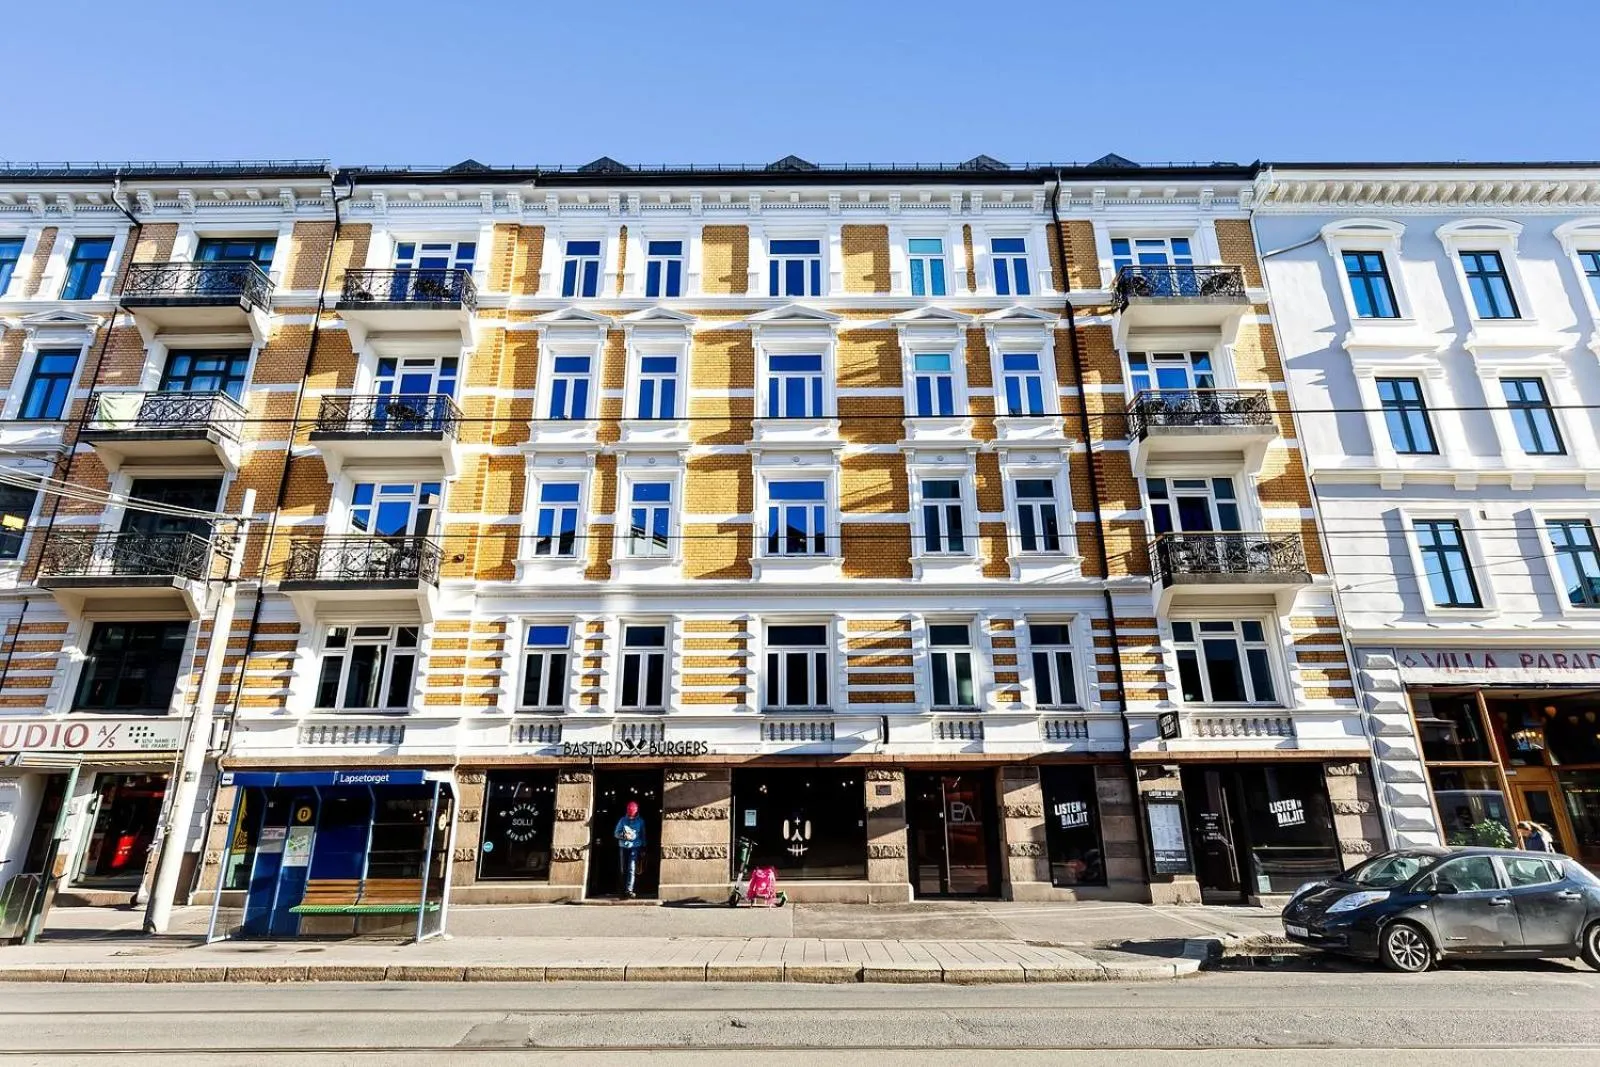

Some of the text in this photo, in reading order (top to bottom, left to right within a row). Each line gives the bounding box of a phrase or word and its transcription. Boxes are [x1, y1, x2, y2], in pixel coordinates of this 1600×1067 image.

[1420, 652, 1498, 669] VILLA
[563, 740, 709, 755] BASTARD BURGERS
[339, 773, 390, 785] Lapsetorget
[1054, 801, 1082, 816] LISTEN
[1269, 799, 1297, 814] LISTEN
[512, 818, 533, 826] SOLLI
[1060, 811, 1088, 826] BALJIT
[1277, 809, 1304, 824] BALJIT
